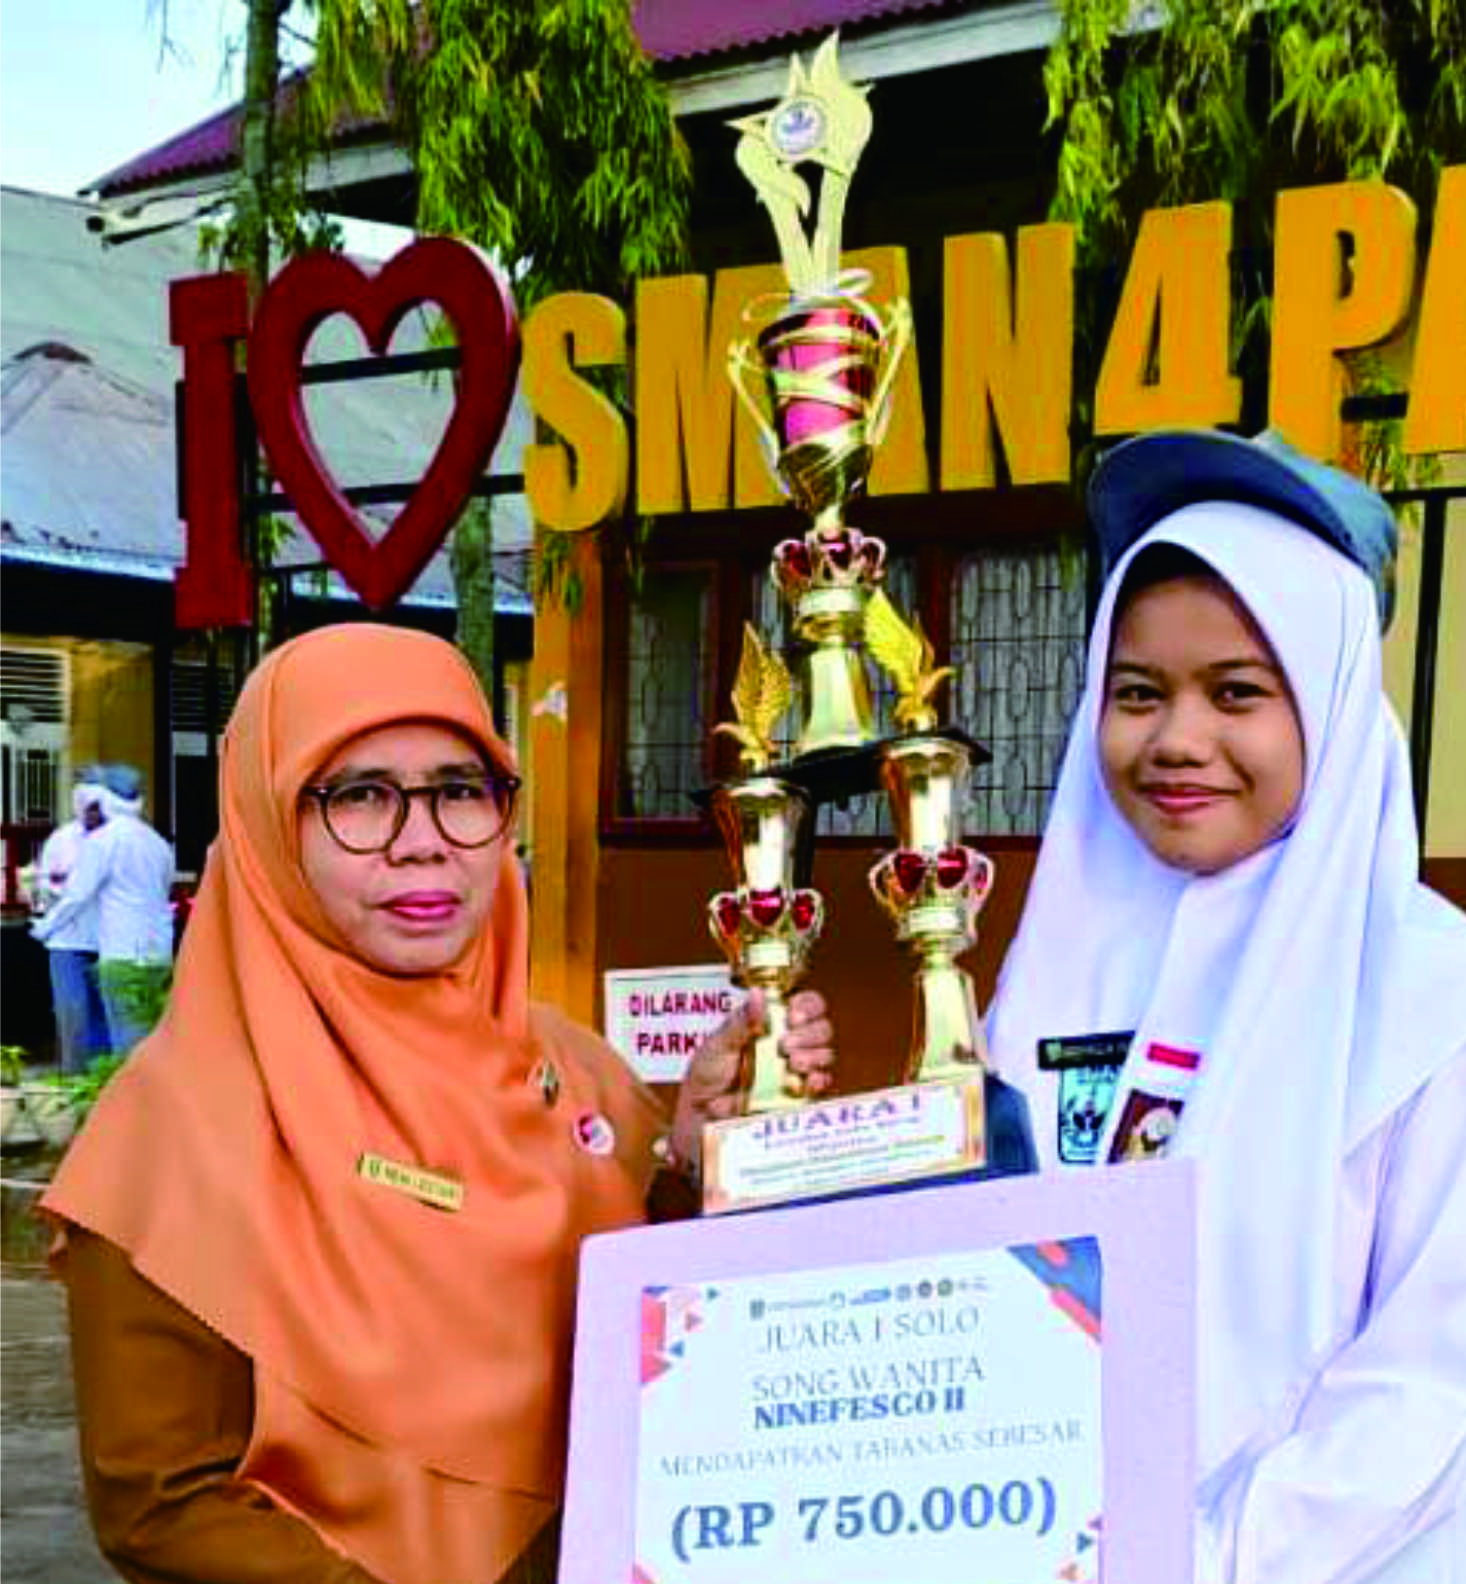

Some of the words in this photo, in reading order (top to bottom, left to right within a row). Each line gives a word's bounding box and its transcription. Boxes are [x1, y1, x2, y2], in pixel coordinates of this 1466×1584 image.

[628, 992, 732, 1017] DILARANG
[636, 1031, 700, 1055] PARK
[763, 1318, 862, 1353] JUARA
[893, 1306, 980, 1338] SOLO
[751, 1371, 840, 1403] SONG
[846, 1354, 986, 1393] WANITA
[753, 1391, 937, 1430] NINEFESCO
[944, 1386, 966, 1413] II
[659, 1440, 844, 1478] MENDAPATKAN
[972, 1418, 1082, 1447] SEBESAR
[671, 1502, 775, 1563] (RP
[798, 1475, 1057, 1543] 750.000)
